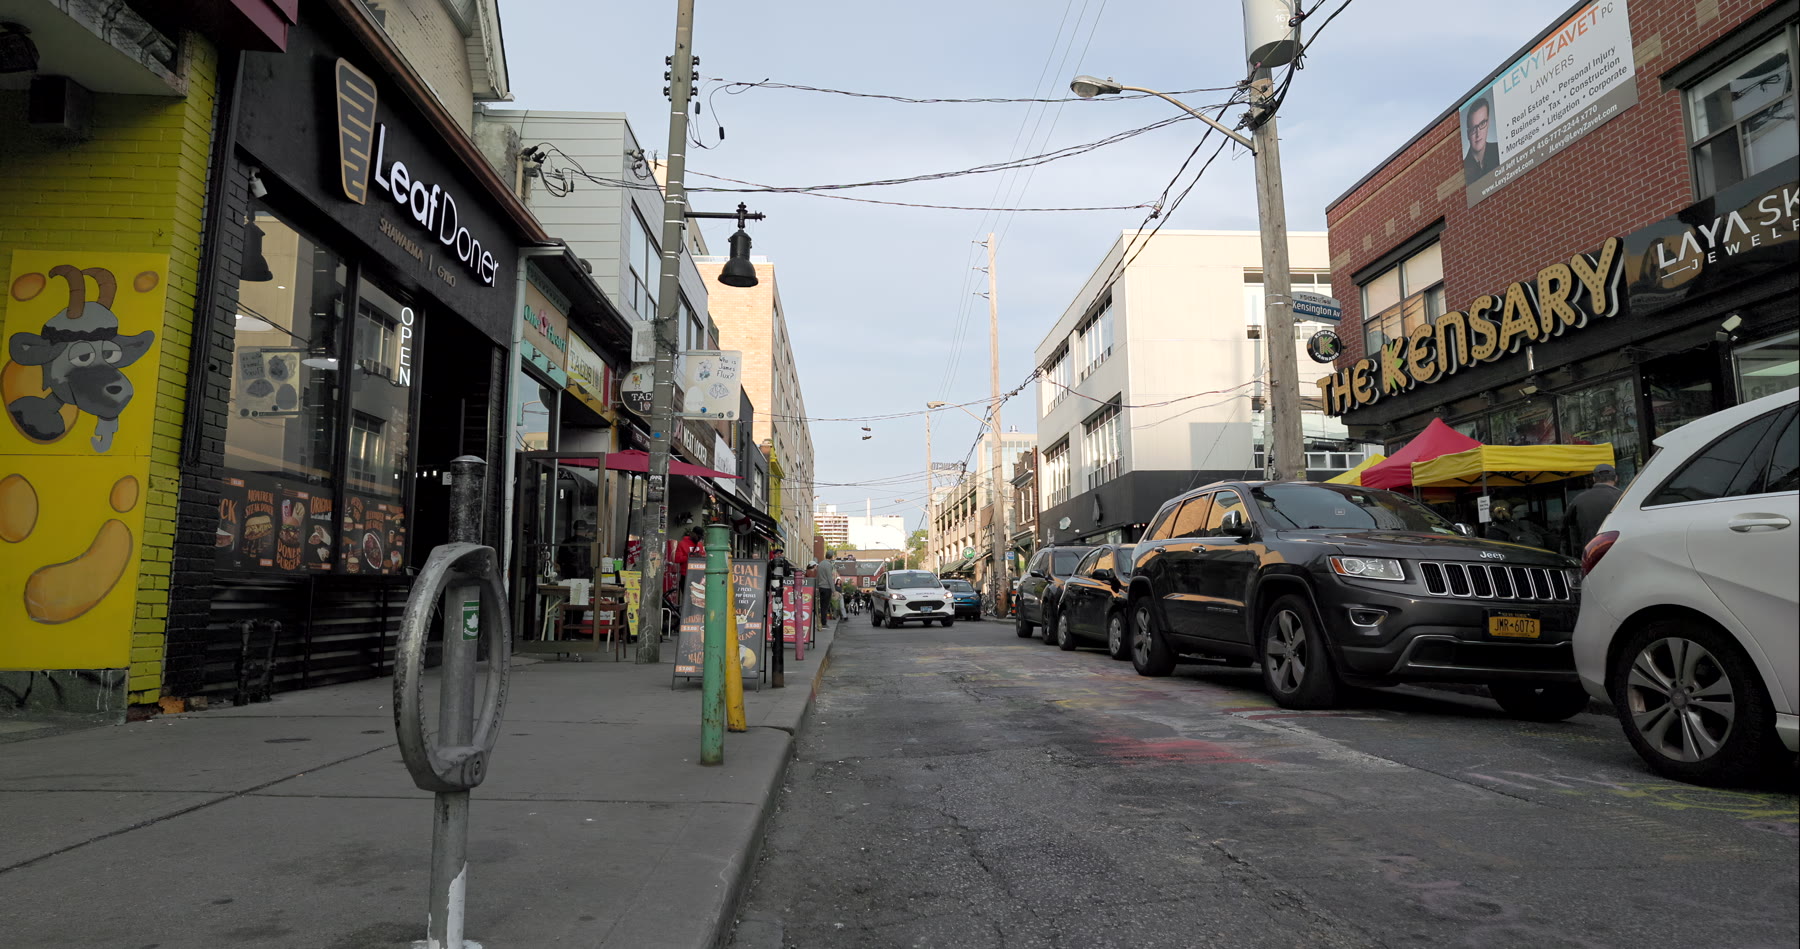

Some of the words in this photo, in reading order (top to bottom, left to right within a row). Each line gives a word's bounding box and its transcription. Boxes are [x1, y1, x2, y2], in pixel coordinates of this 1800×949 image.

[1503, 53, 1541, 95] LEVY
[1546, 5, 1599, 62] ZAVET
[1601, 1, 1614, 19] PC
[1510, 113, 1541, 138] Business
[1548, 99, 1561, 112] Tax
[1569, 56, 1621, 97] Construction
[1511, 110, 1527, 126] Real
[1528, 94, 1550, 114] Estate
[1558, 63, 1592, 92] Personal
[1593, 44, 1616, 67] Injury
[1530, 53, 1575, 95] LAWYERS
[1505, 126, 1540, 155] Mortgages
[1547, 98, 1580, 125] Litigation
[1588, 65, 1628, 97] Corporate
[1494, 166, 1505, 178] Call
[1505, 158, 1516, 171] Jeff
[1516, 151, 1529, 165] Levy
[1529, 146, 1536, 154] at
[1580, 104, 1598, 121] x770
[1481, 157, 1535, 197] www.LevyZavet.com
[375, 122, 441, 231] Leaf
[440, 191, 499, 288] Doner
[379, 218, 424, 262] SHAWARMA
[1657, 210, 1751, 269] LAYA
[524, 305, 541, 330] One
[547, 323, 567, 353] Heart
[1292, 300, 1332, 316] Kensington
[1316, 358, 1372, 416] THE
[1380, 236, 1621, 395] KENSARY
[399, 306, 415, 388] OPEN
[718, 356, 729, 364] Who
[718, 363, 736, 372] James
[631, 392, 653, 401] TAC
[716, 369, 735, 380] Flux?
[1480, 550, 1505, 561] Jeep
[732, 574, 762, 590] DEAL
